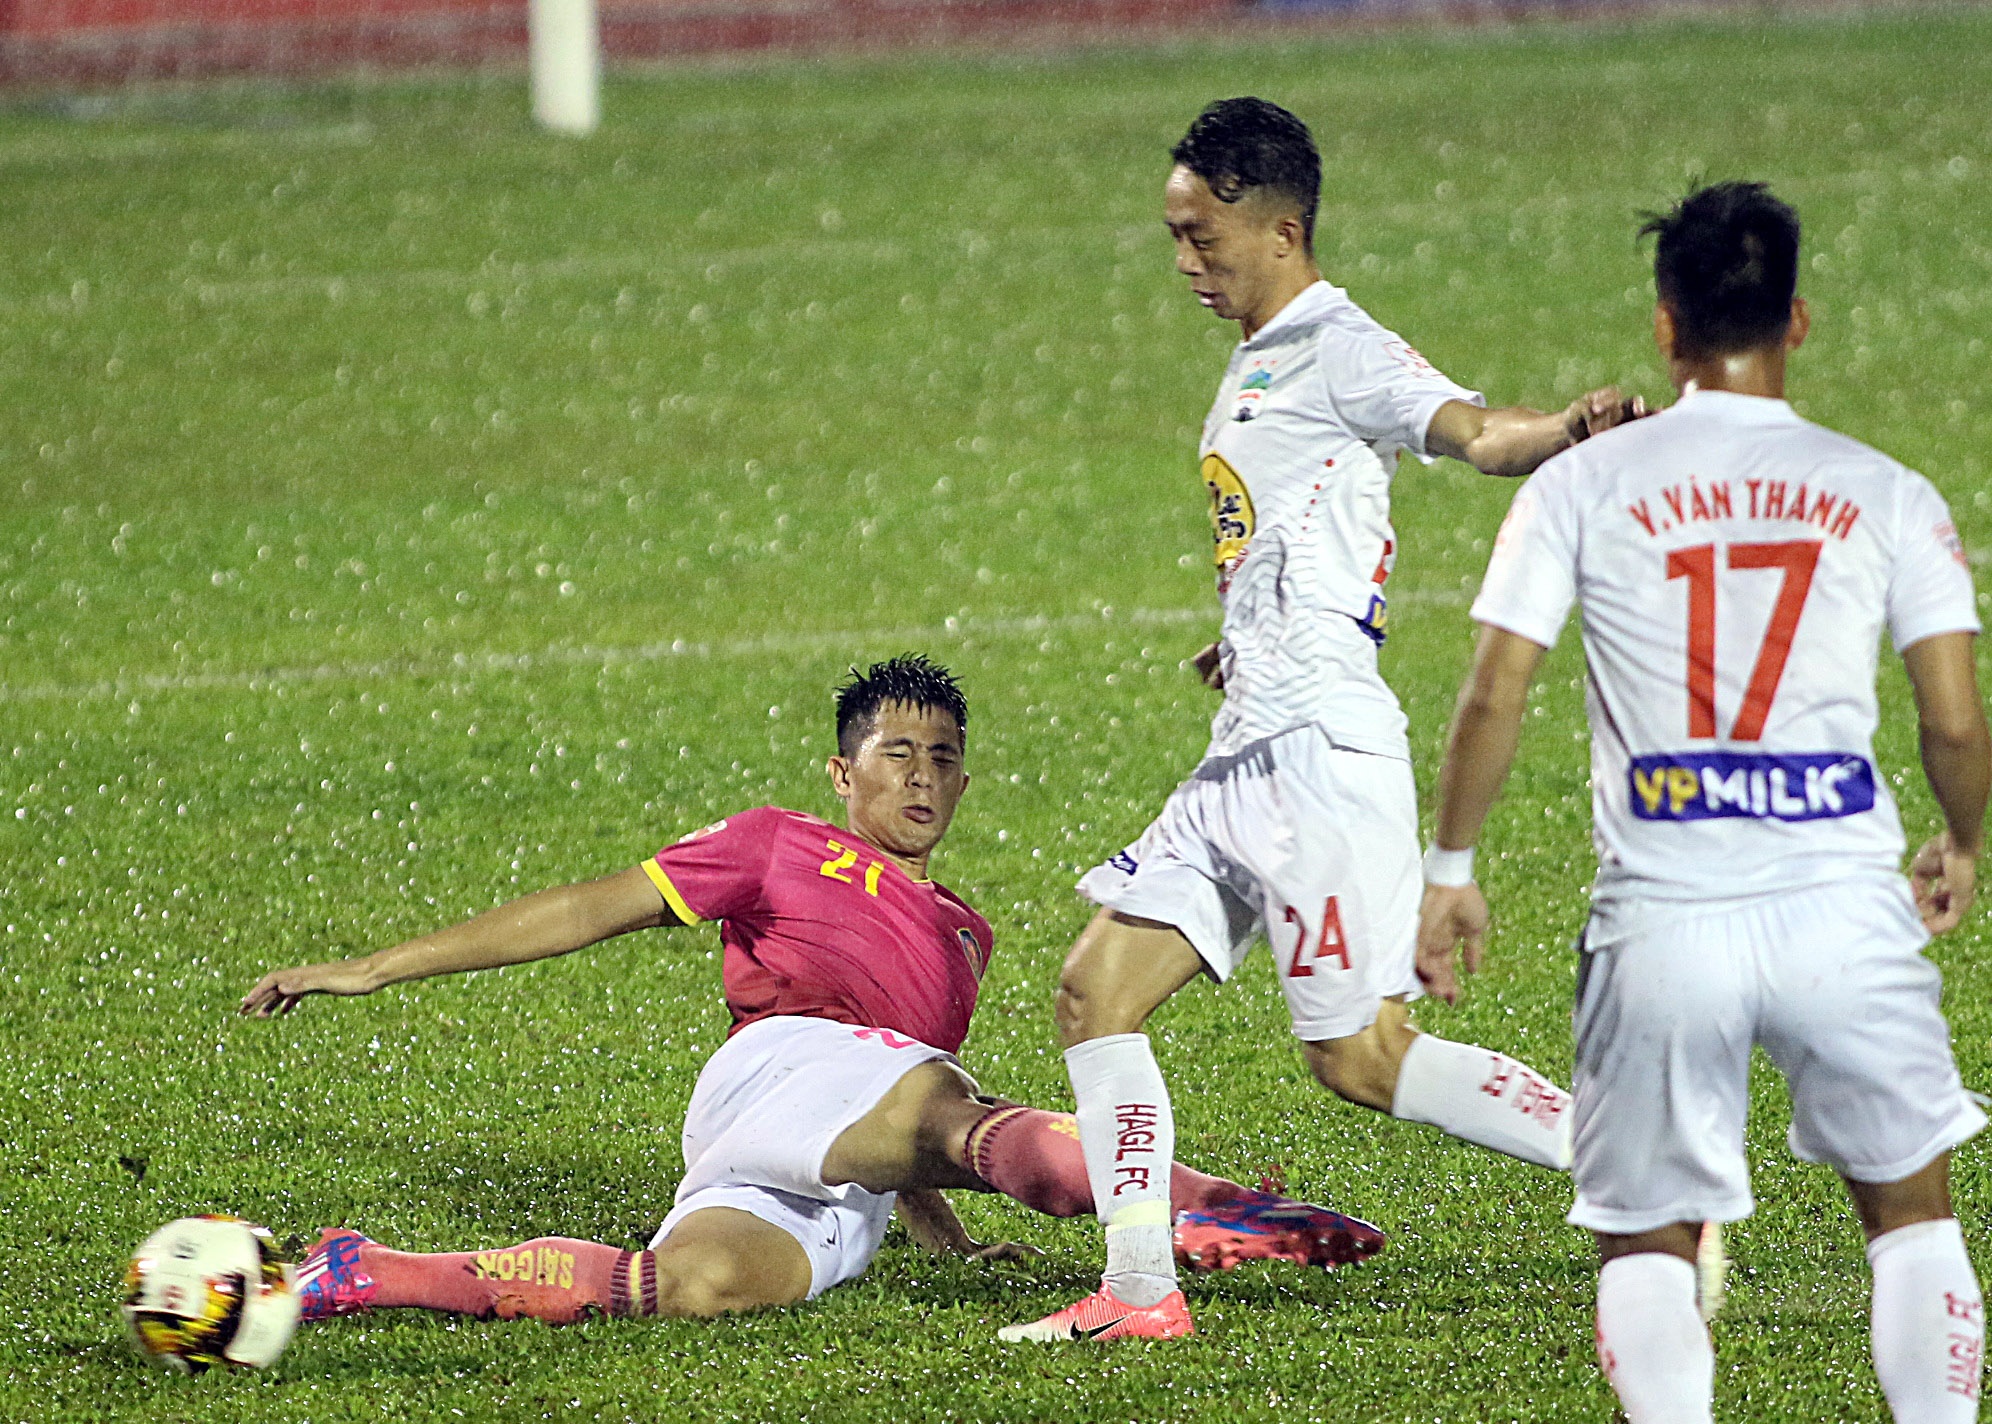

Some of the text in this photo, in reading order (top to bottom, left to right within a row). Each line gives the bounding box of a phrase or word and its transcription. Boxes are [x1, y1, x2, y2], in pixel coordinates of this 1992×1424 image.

[1745, 479, 1861, 541] THANH
[1665, 538, 1825, 742] 17
[820, 839, 884, 897] 21
[1283, 895, 1352, 978] 24
[1113, 1104, 1157, 1196] HAGL FC
[477, 1247, 575, 1289] SAIGON
